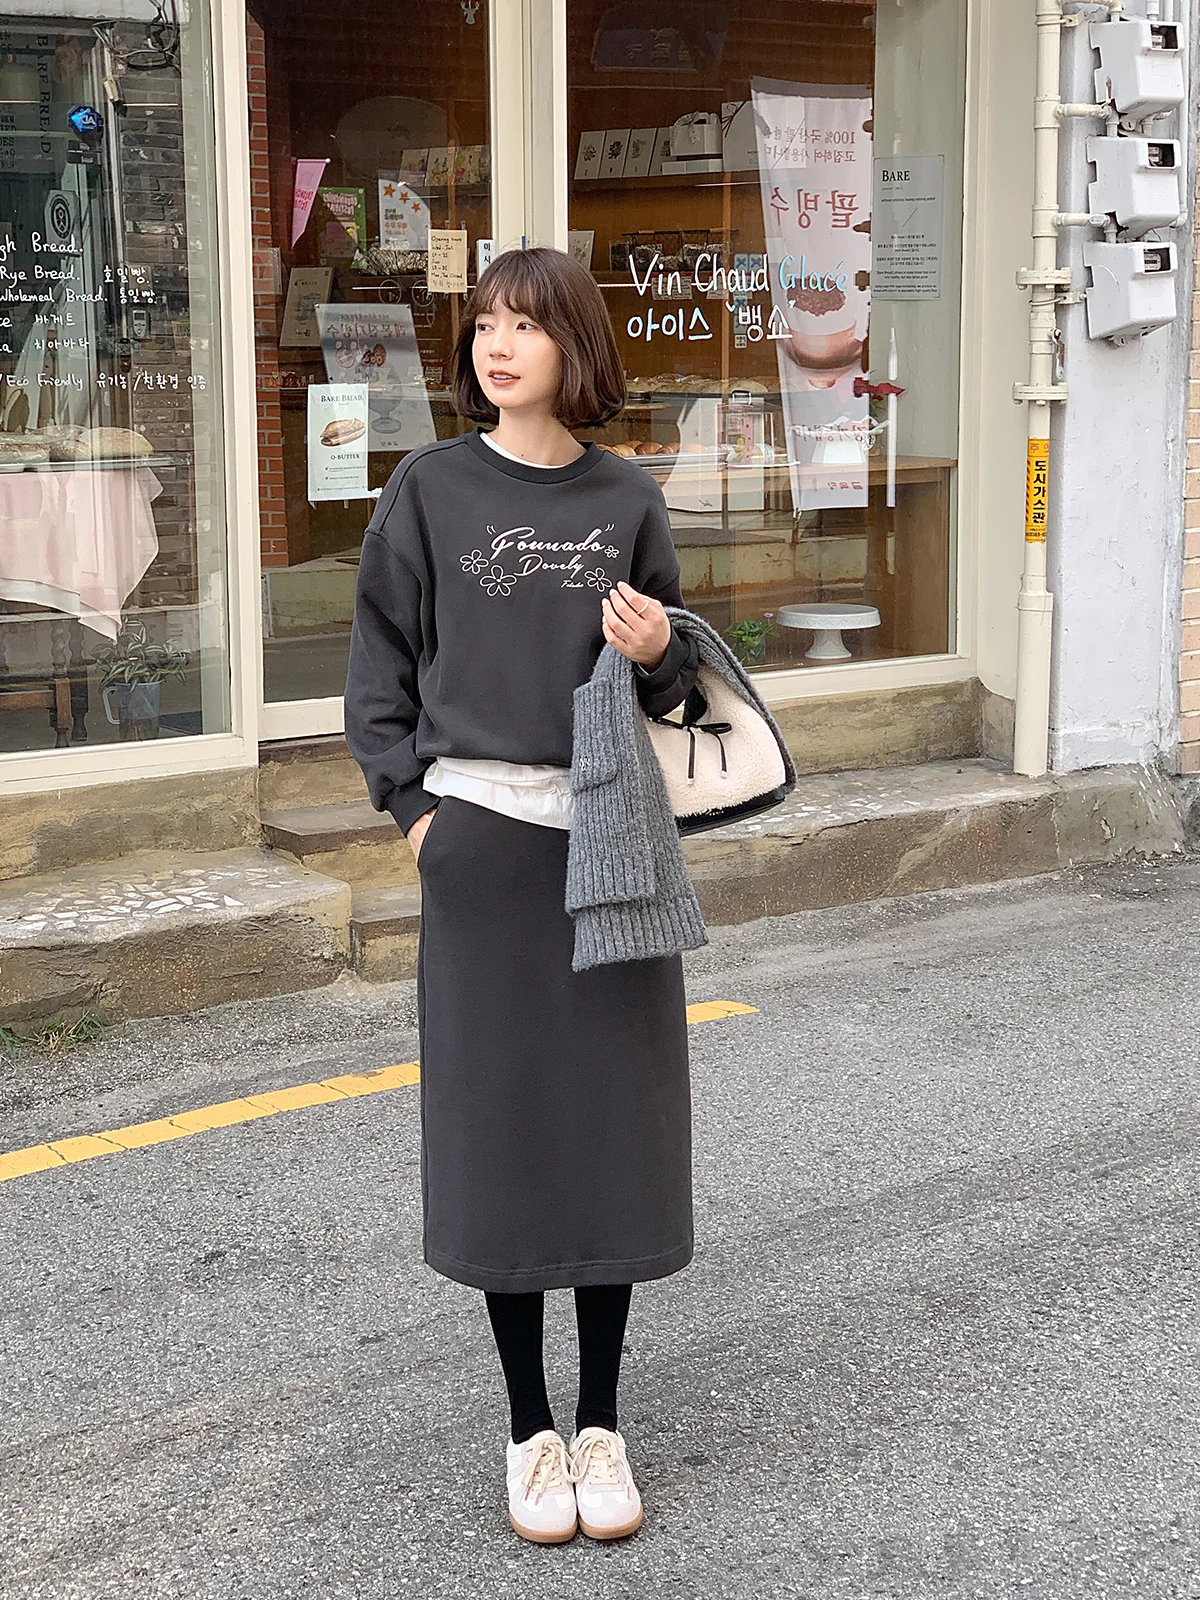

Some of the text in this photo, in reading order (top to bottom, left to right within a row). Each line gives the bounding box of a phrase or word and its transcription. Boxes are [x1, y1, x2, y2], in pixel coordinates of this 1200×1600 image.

[881, 169, 911, 182] BARE
[32, 231, 84, 252] Bread.
[0, 267, 27, 288] Rye
[35, 265, 80, 281] Bread.
[628, 253, 682, 296] Vin
[694, 253, 770, 292] Chaud
[779, 254, 848, 292] Glacé
[66, 285, 108, 302] Bread.
[35, 312, 76, 326] 바게트
[627, 306, 713, 342] 아이스
[34, 339, 90, 351] 치아바타
[37, 373, 83, 390] Friendly
[96, 373, 127, 389] 유기농
[187, 375, 207, 390] 인증
[1032, 460, 1047, 524] 도시가스관
